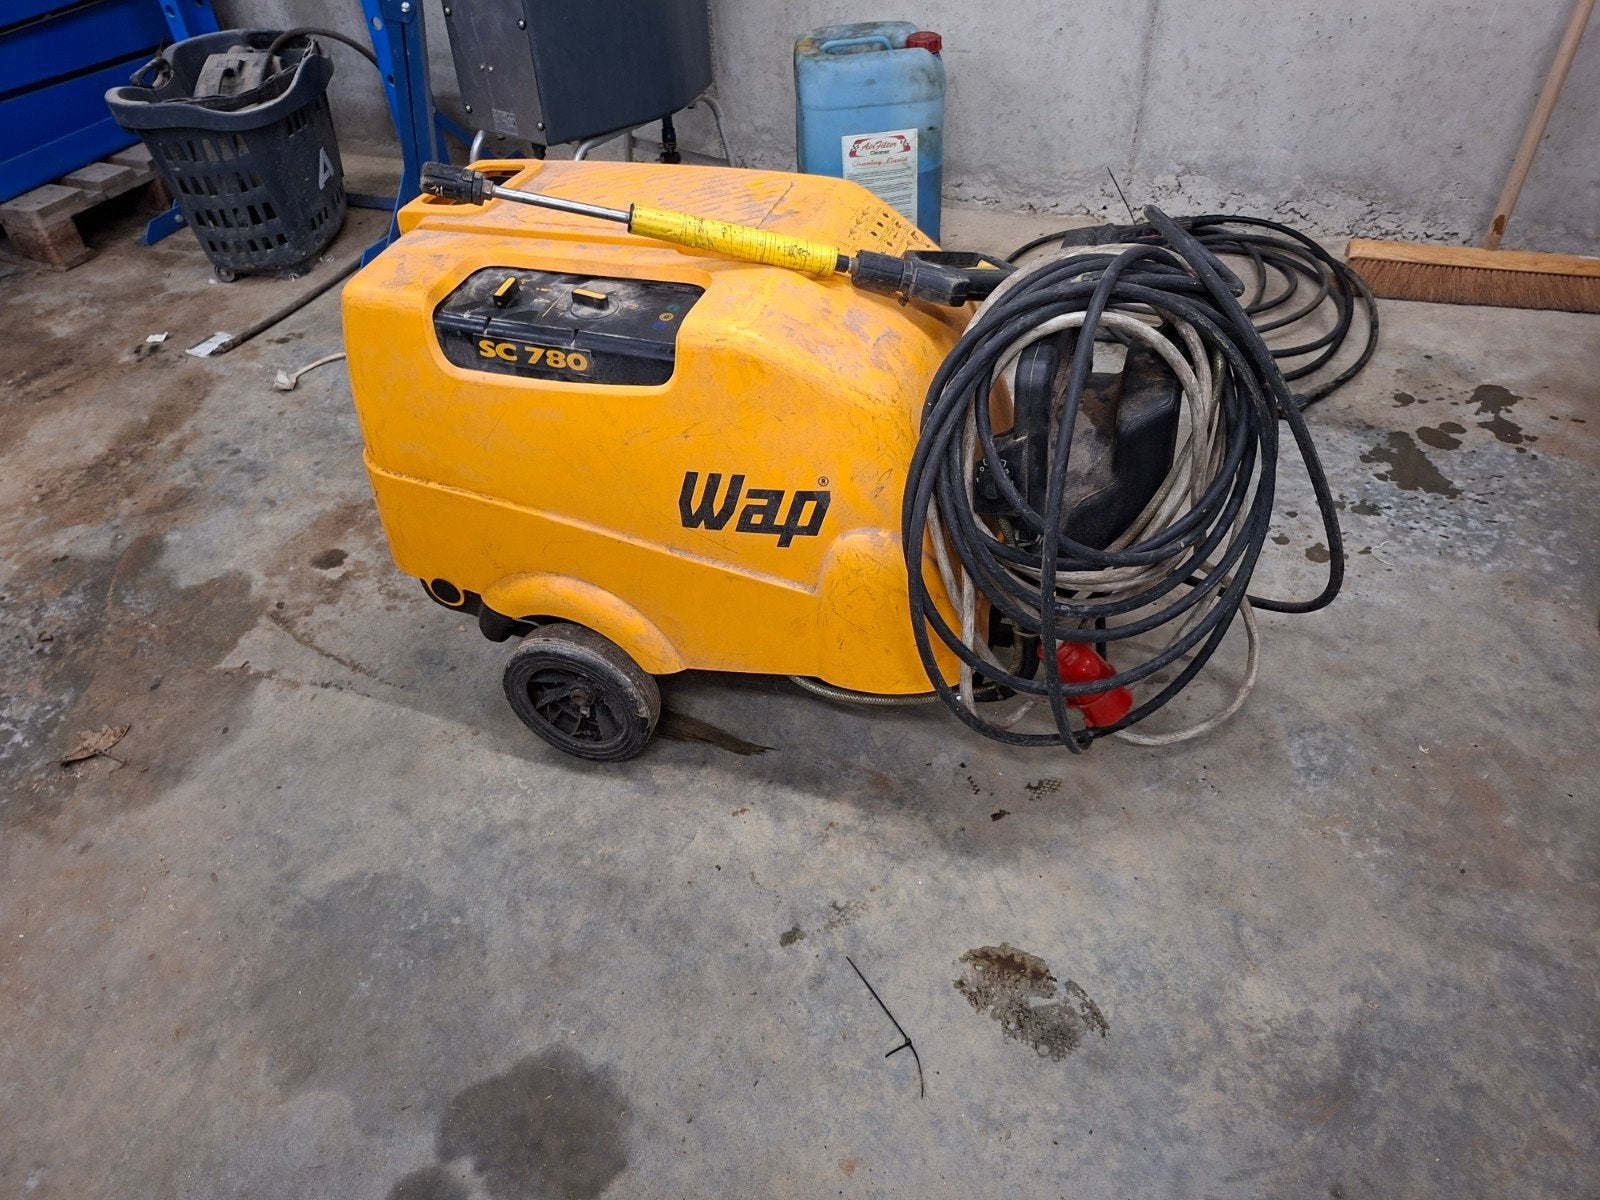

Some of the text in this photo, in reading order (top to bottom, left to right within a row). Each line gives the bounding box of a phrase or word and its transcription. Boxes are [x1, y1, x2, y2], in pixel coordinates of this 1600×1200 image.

[478, 339, 588, 371] SC 780
[678, 471, 831, 548] Wap
